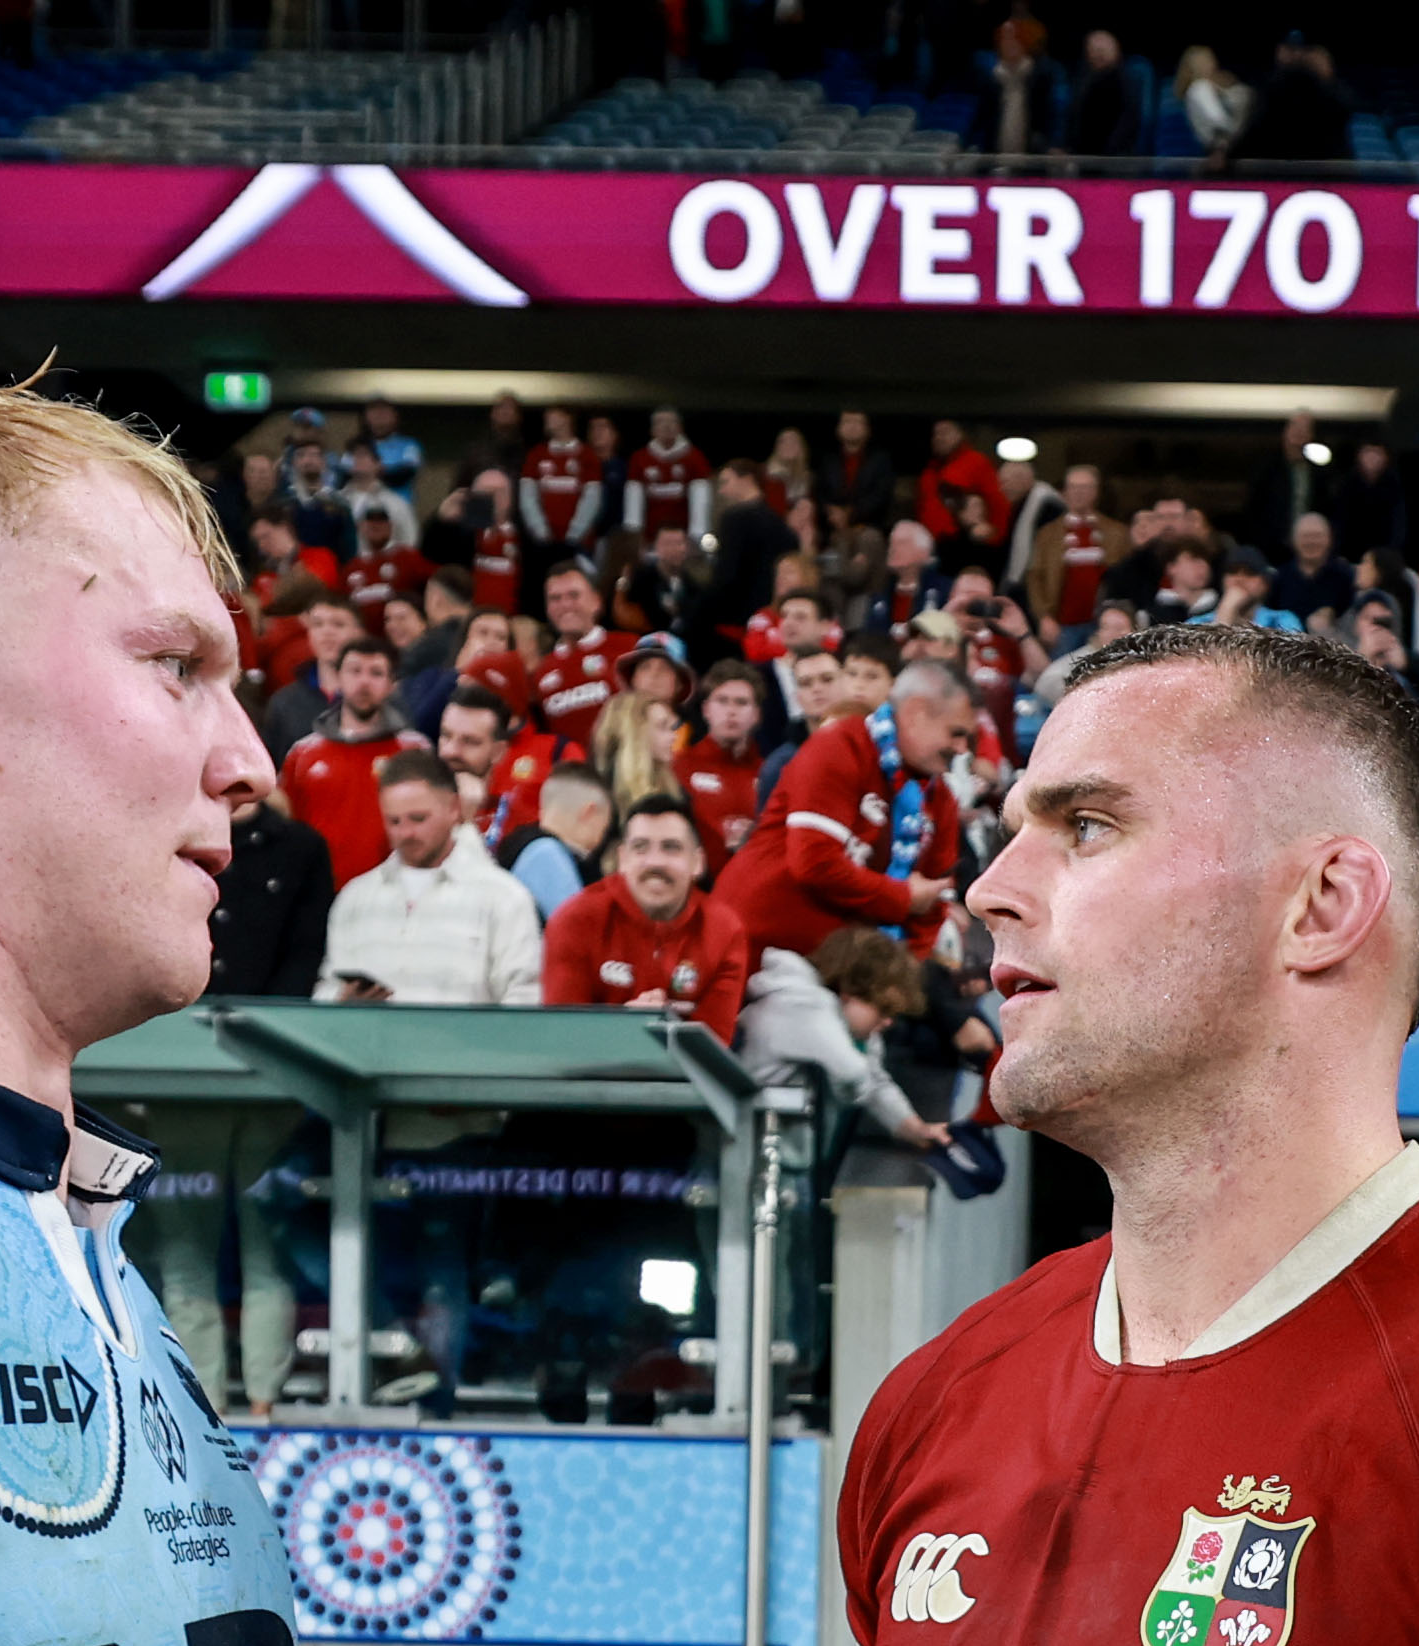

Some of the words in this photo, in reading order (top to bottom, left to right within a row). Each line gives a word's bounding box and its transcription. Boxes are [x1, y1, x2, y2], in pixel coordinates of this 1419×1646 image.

[668, 179, 1083, 306] OVER
[1130, 189, 1363, 312] 170
[168, 1532, 230, 1566] Strategies
